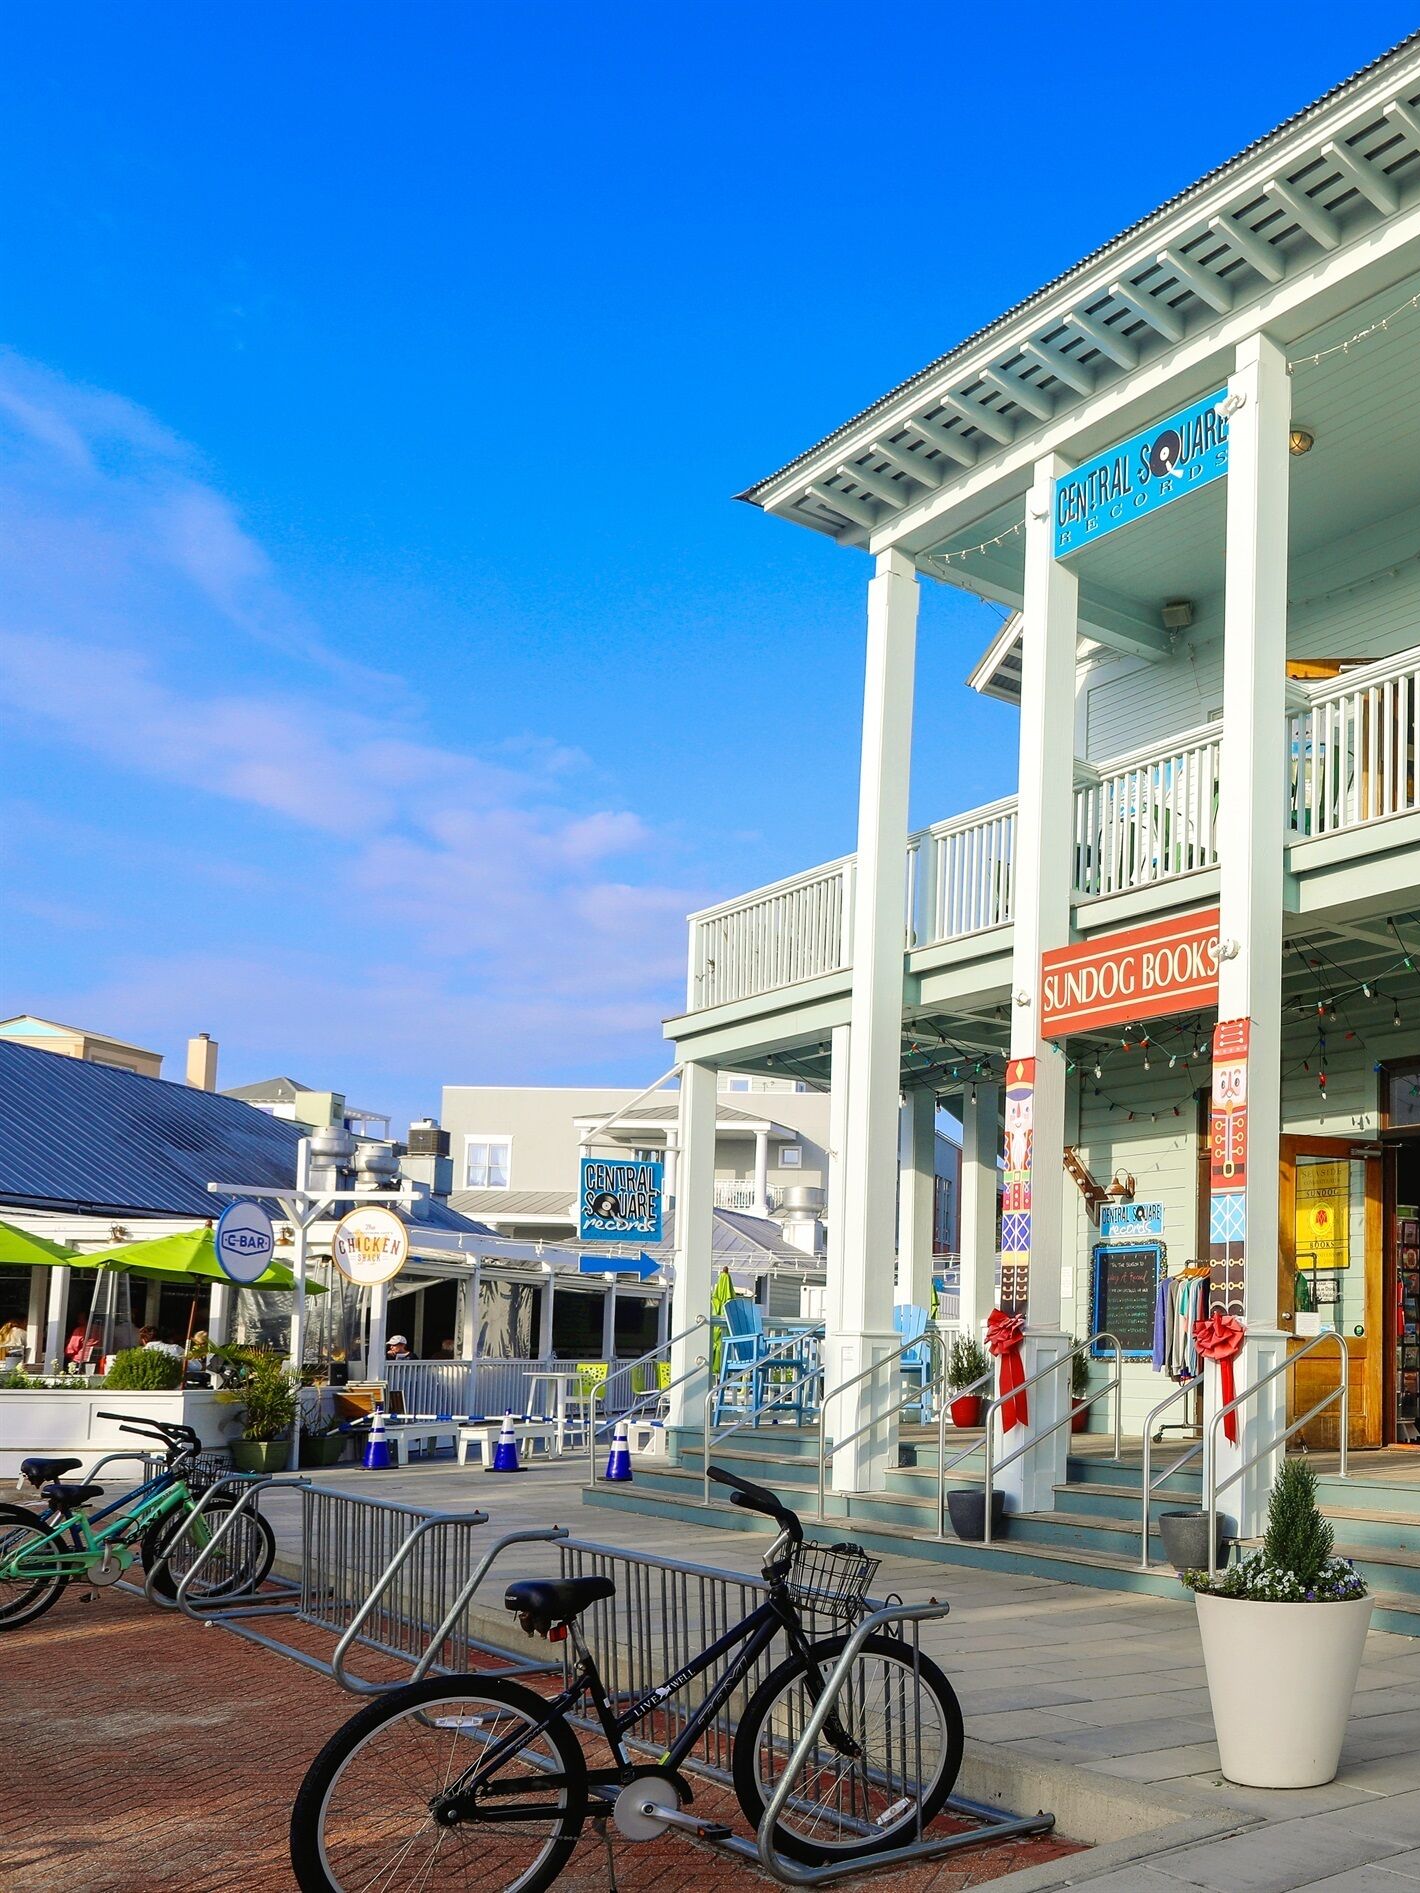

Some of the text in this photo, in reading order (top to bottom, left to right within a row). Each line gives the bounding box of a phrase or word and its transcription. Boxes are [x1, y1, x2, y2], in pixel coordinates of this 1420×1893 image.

[1058, 455, 1133, 527] CENTRAL
[1059, 450, 1228, 547] RECORDS
[1044, 937, 1219, 1012] SUNDOG BOOKS
[585, 1164, 660, 1193] CENTRAL
[582, 1191, 657, 1220] SQUARE
[1102, 1206, 1130, 1224] CENTRAL
[583, 1218, 656, 1232] records
[1109, 1221, 1152, 1234] records
[338, 1236, 401, 1255] CHICKEN
[634, 1669, 696, 1717] LIVE WELL
